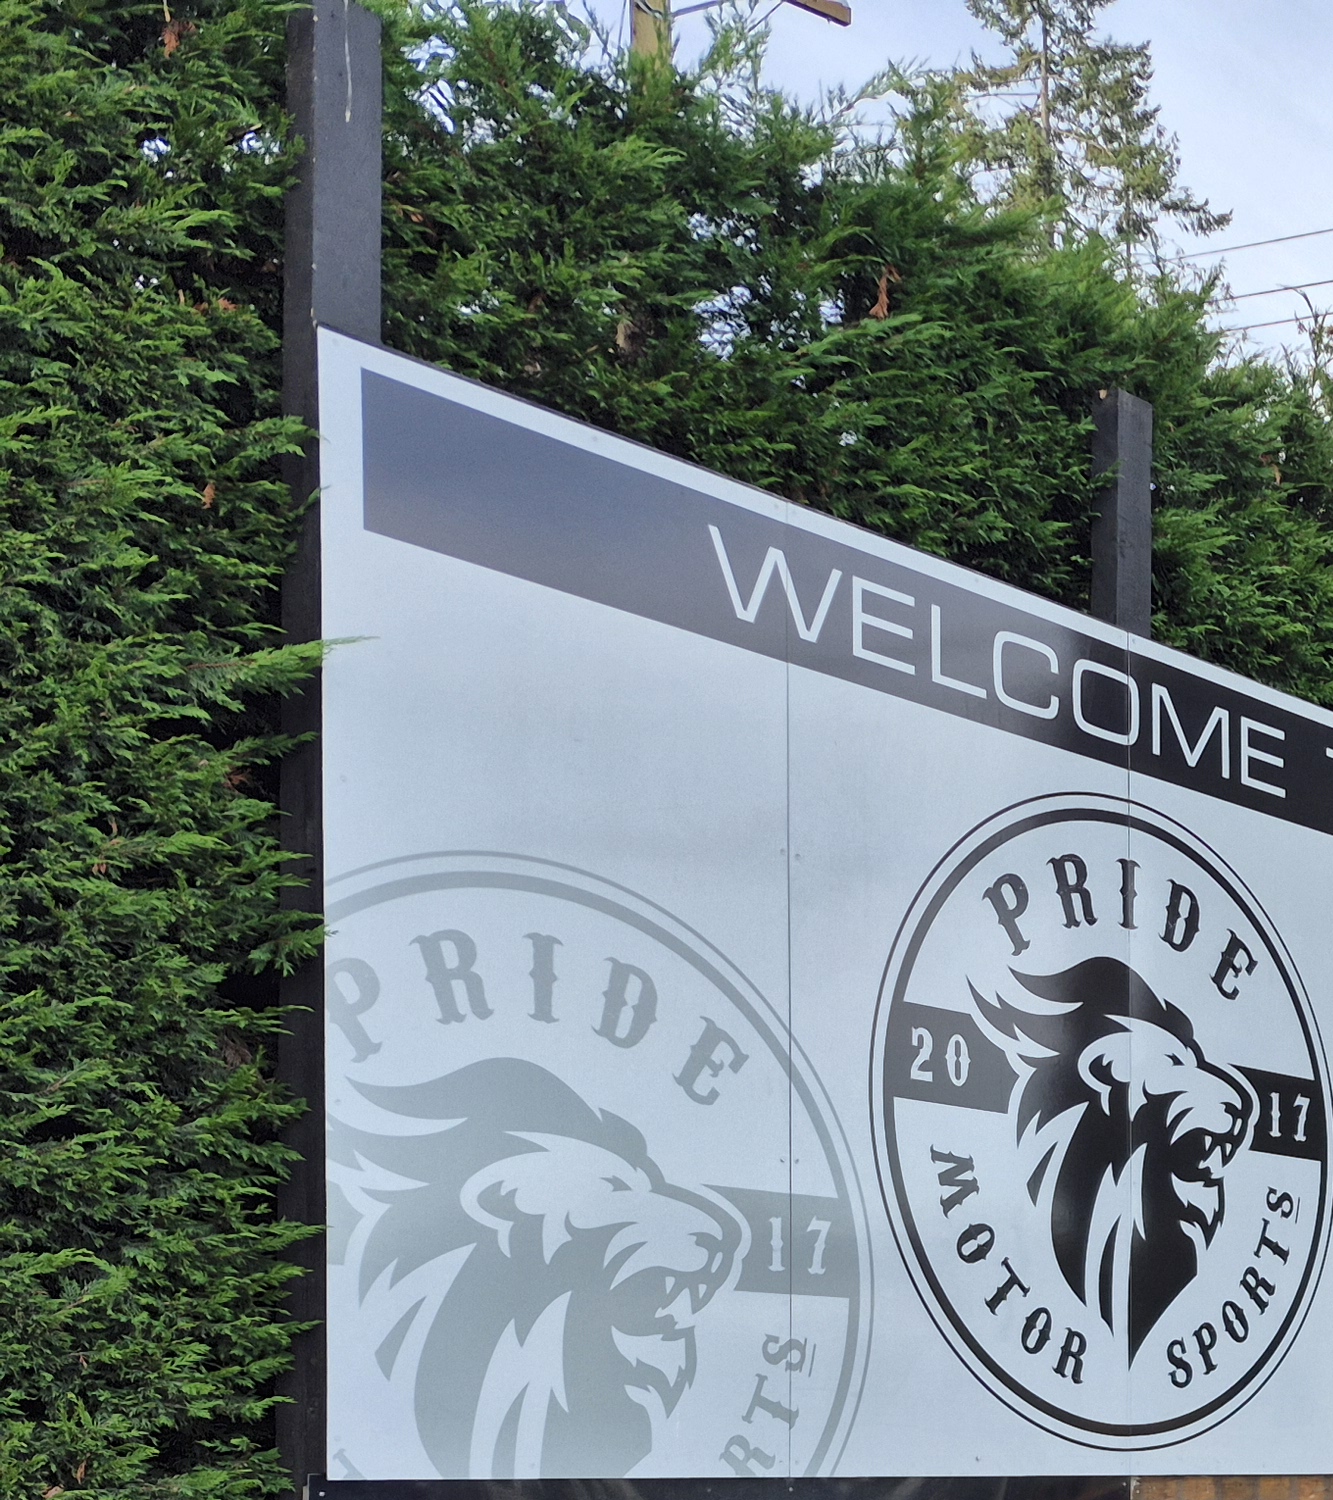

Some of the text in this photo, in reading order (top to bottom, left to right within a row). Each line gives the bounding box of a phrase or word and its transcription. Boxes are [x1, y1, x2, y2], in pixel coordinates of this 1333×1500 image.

[708, 524, 1287, 799] WELCOME
[981, 853, 1259, 1001] PRIDE
[326, 928, 750, 1106] PRIDE
[910, 1026, 1311, 1142] 20 17
[767, 1214, 832, 1276] 17
[929, 1143, 1300, 1389] MOTOR SPORTS
